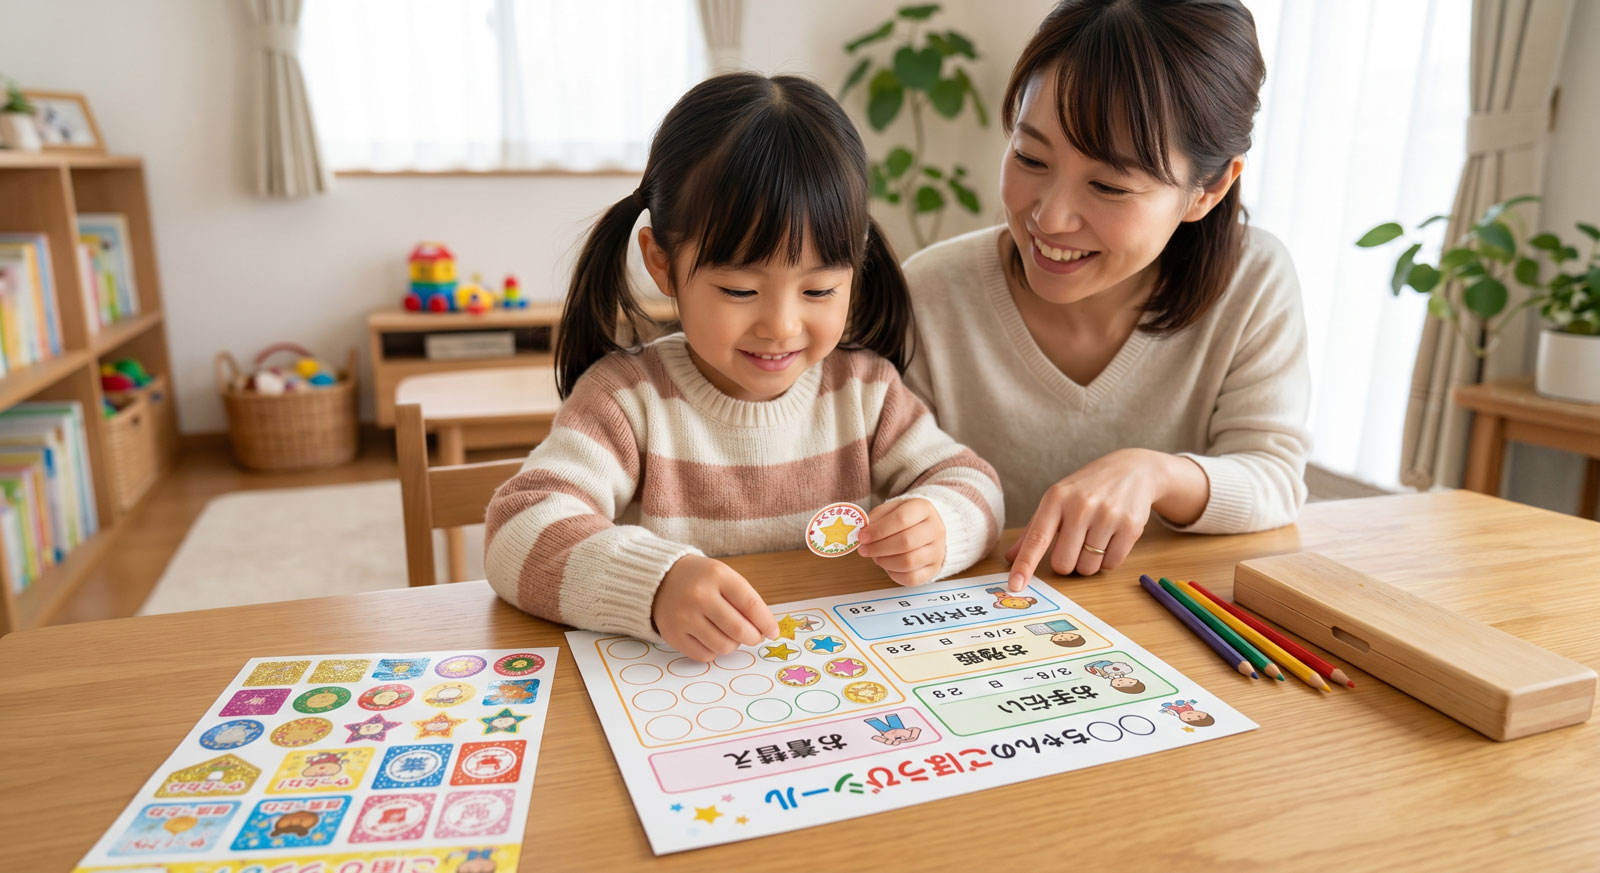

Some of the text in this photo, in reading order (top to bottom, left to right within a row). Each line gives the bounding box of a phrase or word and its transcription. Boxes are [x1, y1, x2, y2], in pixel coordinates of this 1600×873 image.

[886, 643, 916, 655] 28
[932, 687, 964, 700] 28
[997, 685, 1100, 714] お手伝い
[723, 733, 848, 769] お着替え
